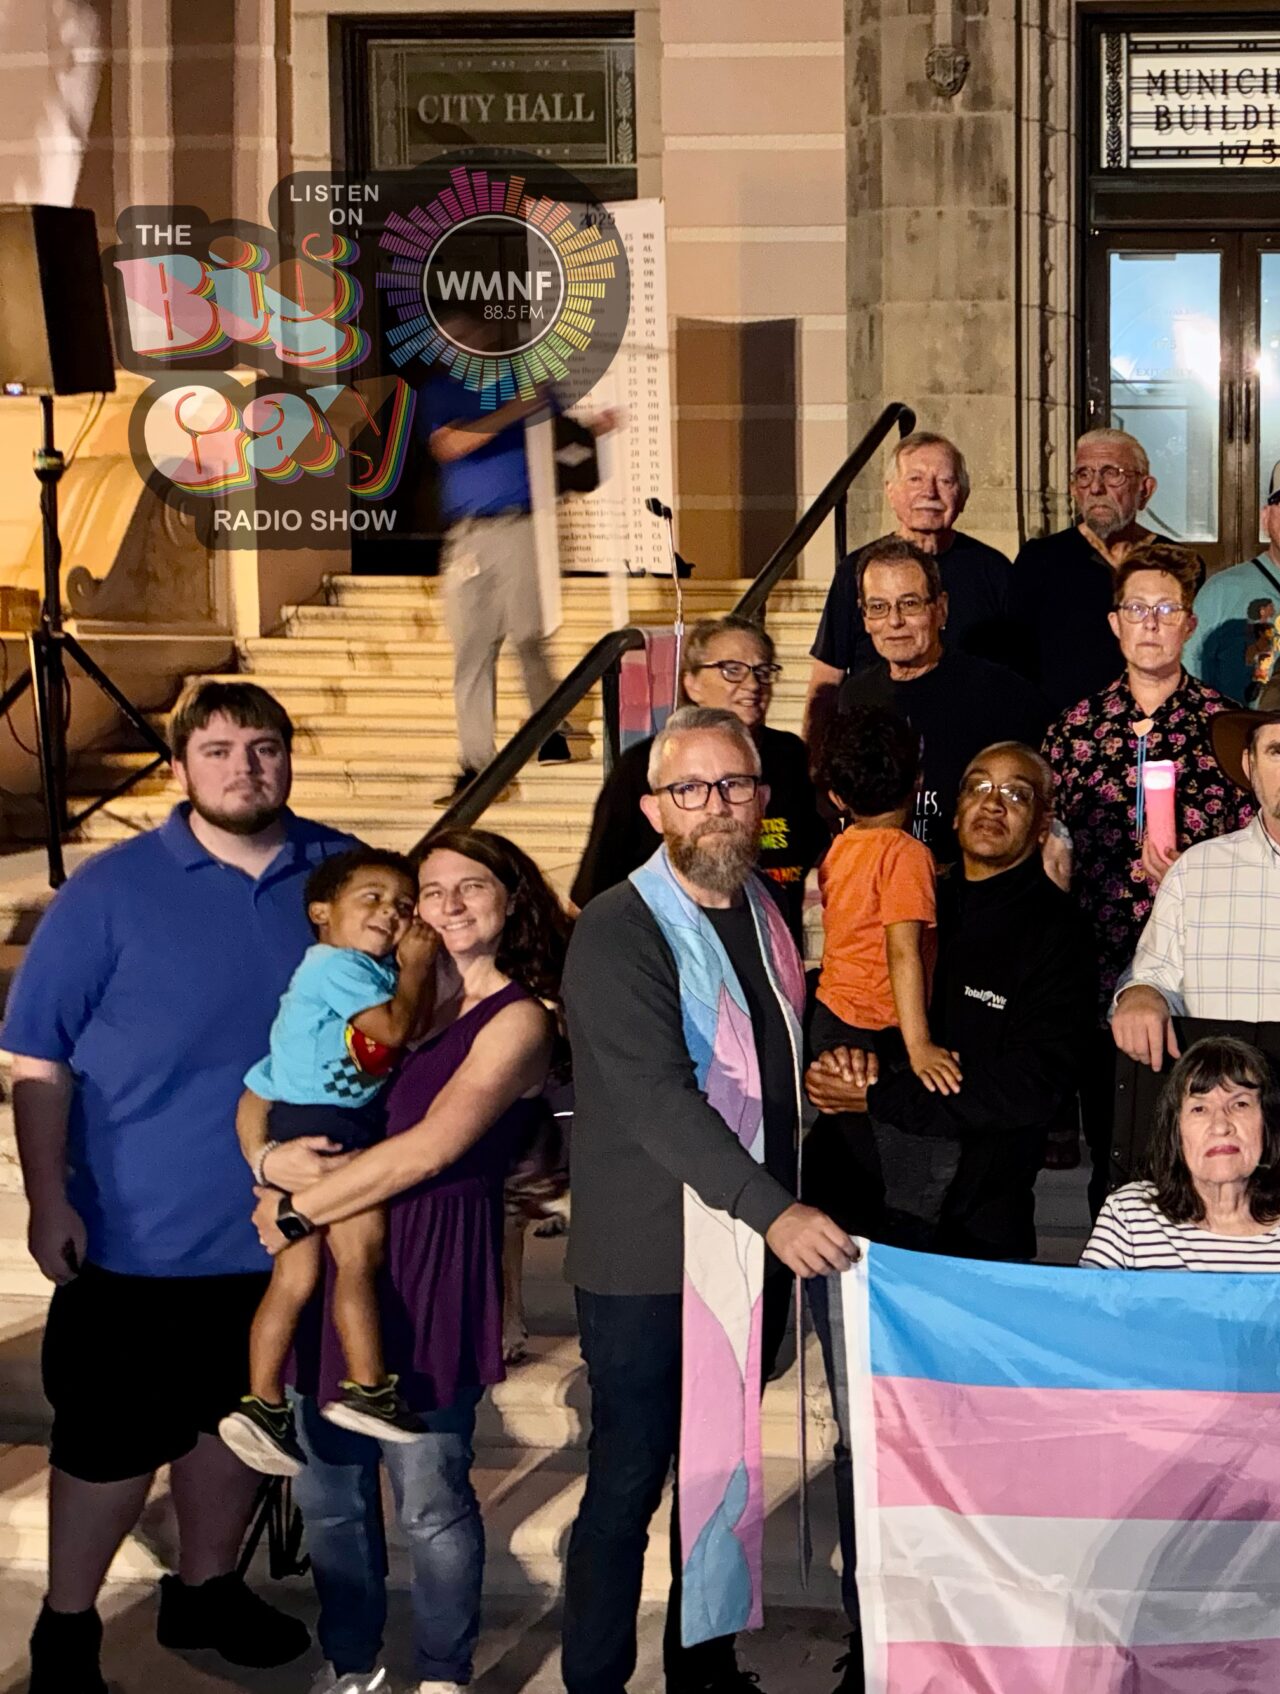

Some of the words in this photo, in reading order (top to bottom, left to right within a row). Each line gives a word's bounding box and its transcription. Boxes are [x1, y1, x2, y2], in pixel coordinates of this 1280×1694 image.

[417, 93, 495, 124] CITY
[504, 92, 595, 122] HALL
[1219, 138, 1276, 165] 175
